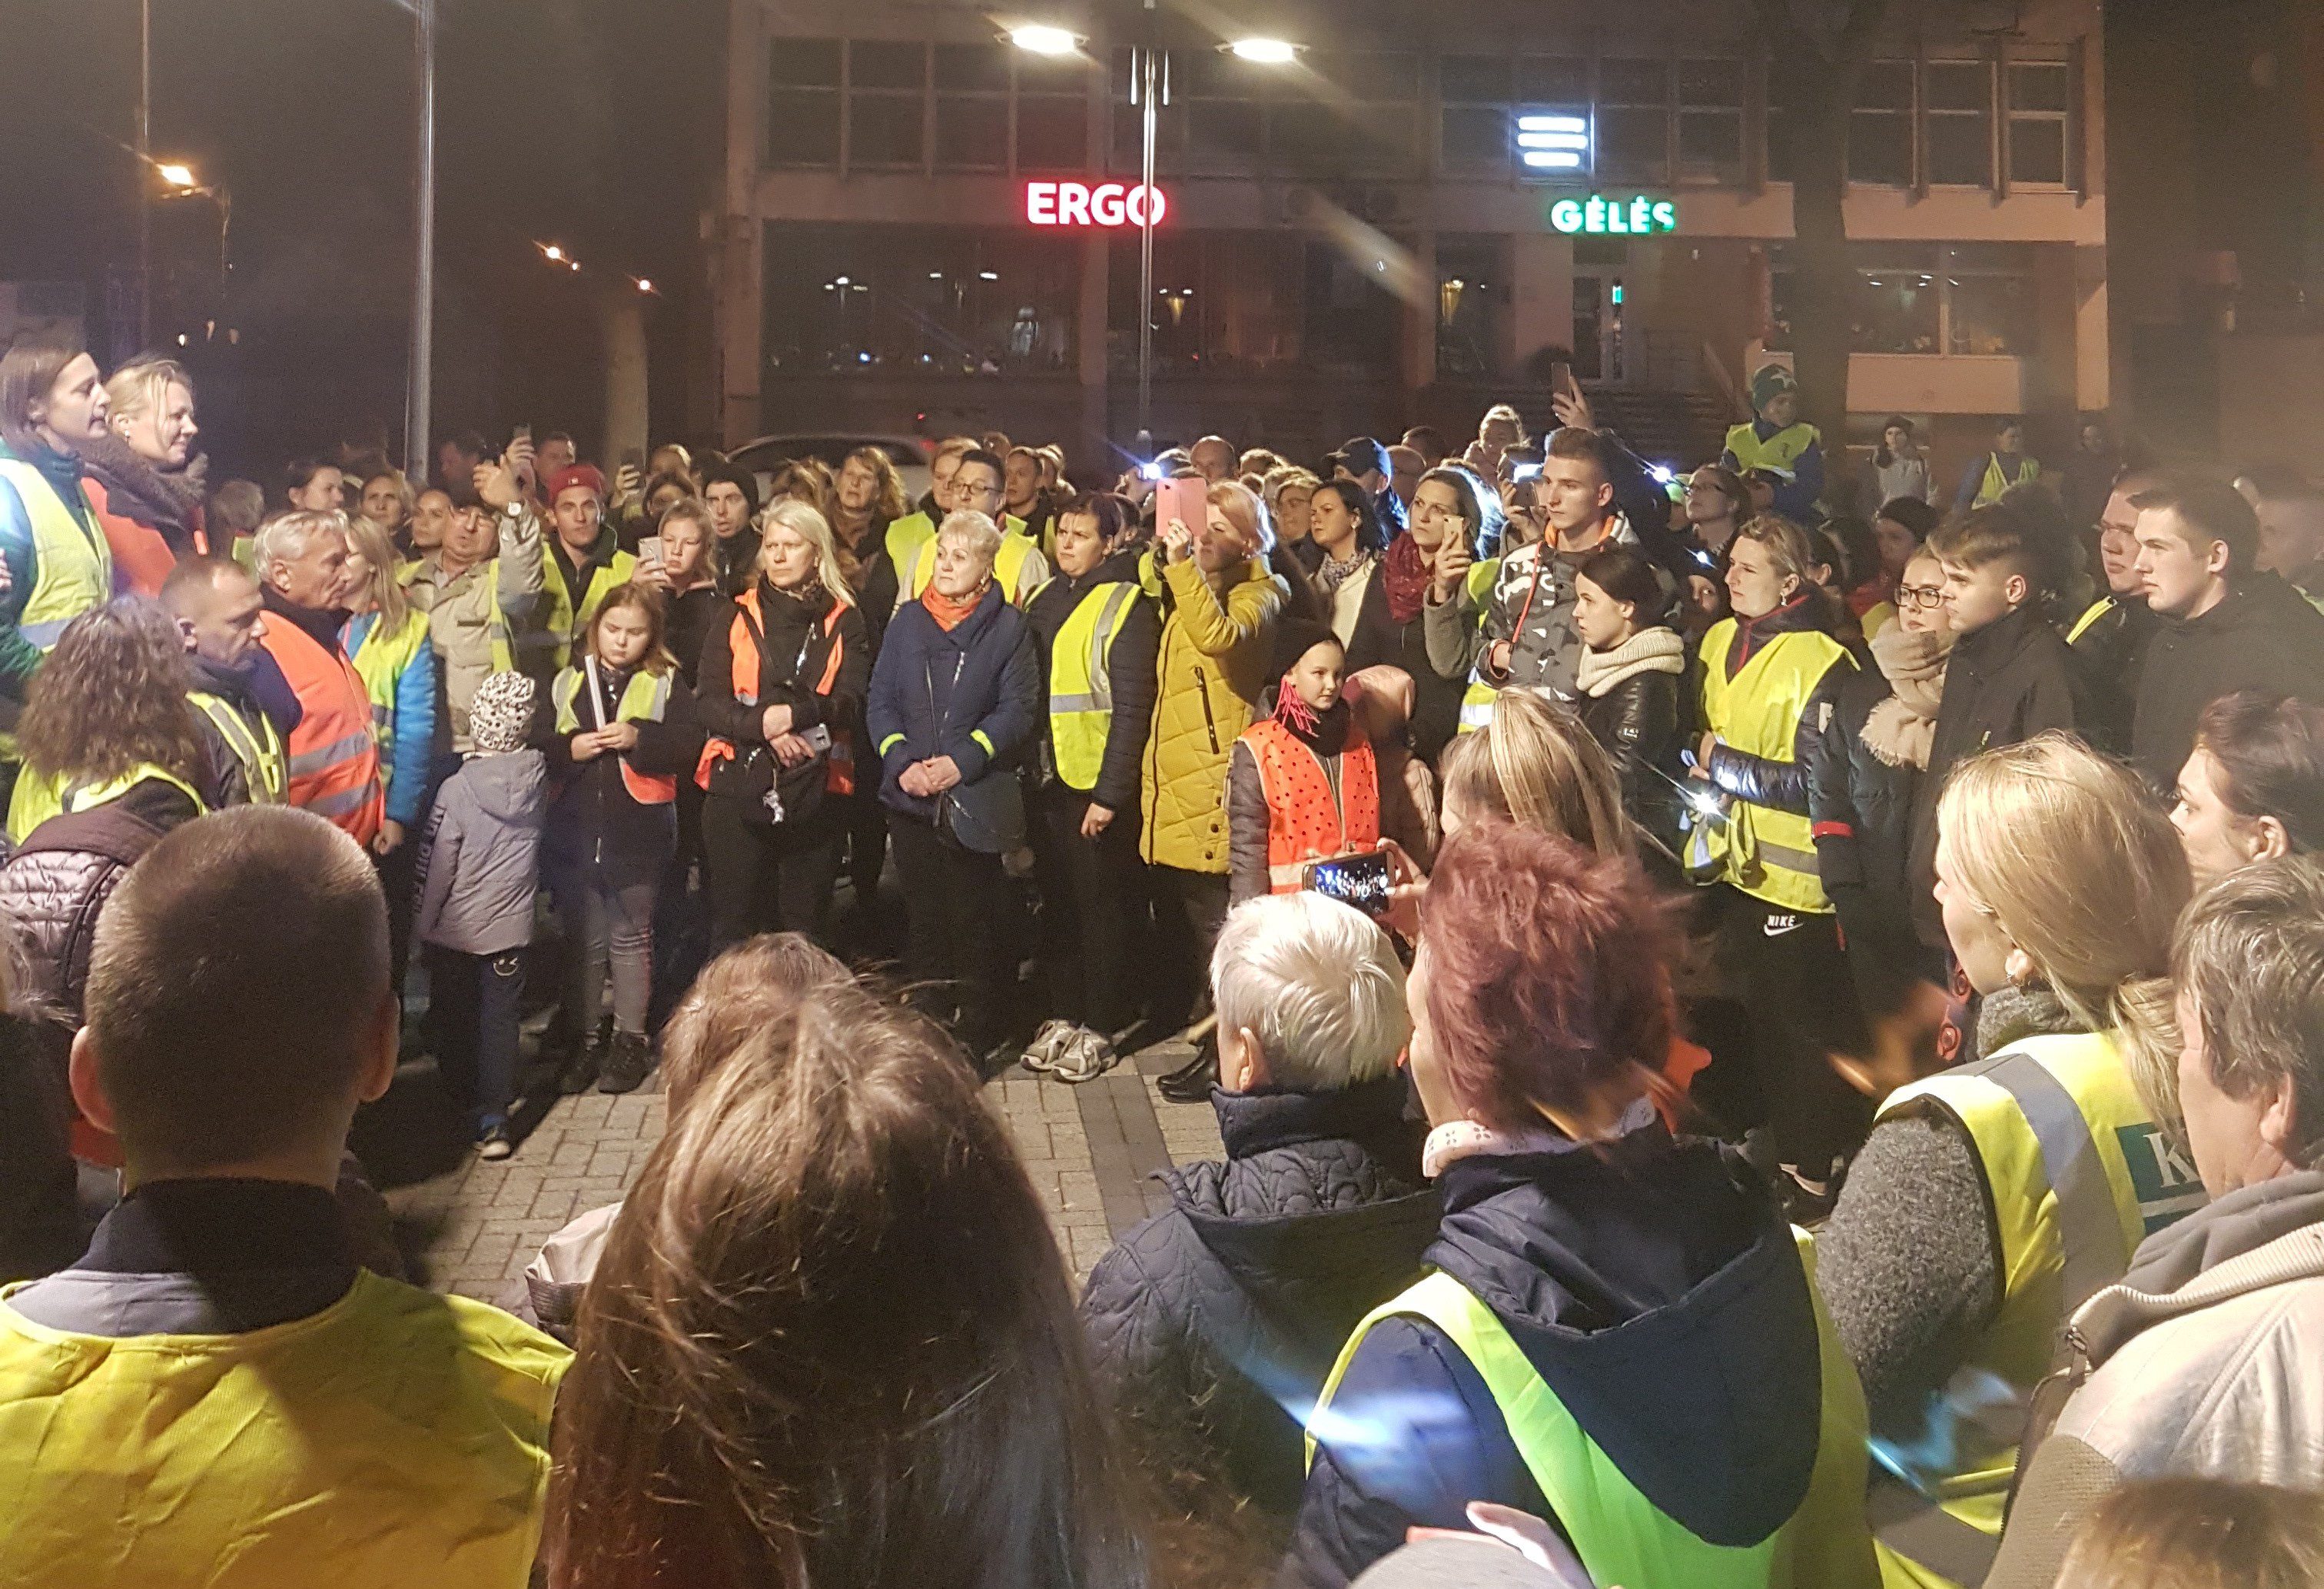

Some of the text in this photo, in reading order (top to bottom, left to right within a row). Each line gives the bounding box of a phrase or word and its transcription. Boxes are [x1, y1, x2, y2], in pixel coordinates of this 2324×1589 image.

[1028, 182, 1166, 227] ERGO
[1551, 194, 1675, 233] GĖLĖS
[1767, 914, 1797, 927] NIKE
